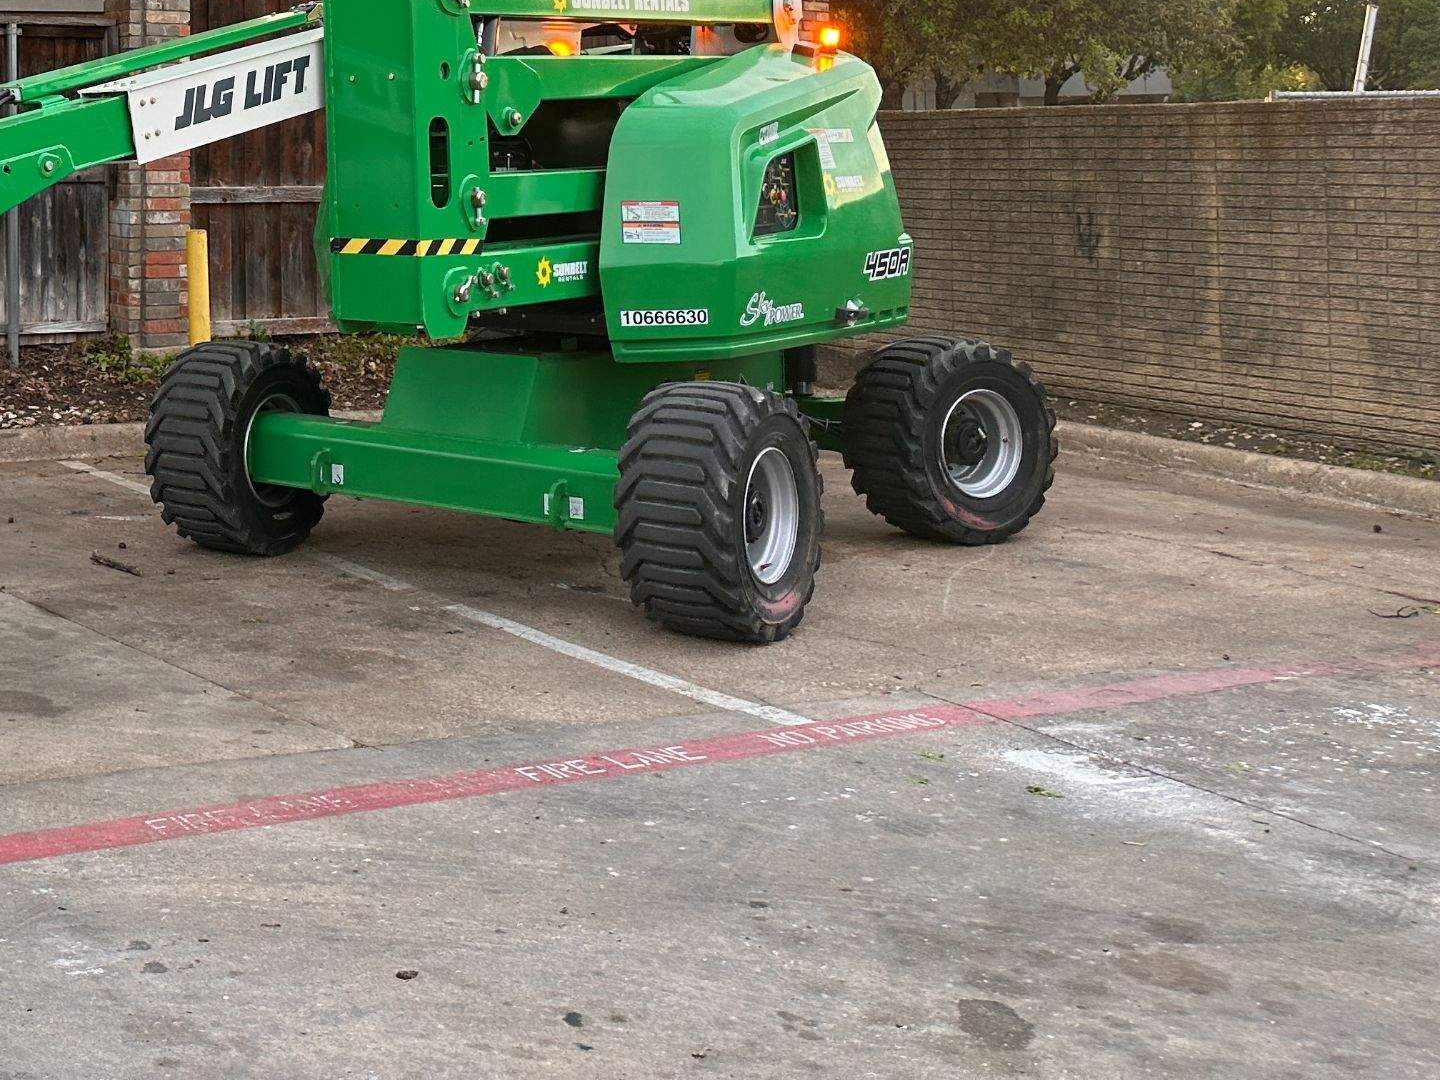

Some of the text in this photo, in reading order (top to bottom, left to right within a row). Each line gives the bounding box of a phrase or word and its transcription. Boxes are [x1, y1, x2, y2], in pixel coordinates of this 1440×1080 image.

[174, 54, 311, 131] JLG LIFT
[552, 261, 588, 276] SUNBELT
[863, 246, 911, 282] 450A
[622, 309, 708, 325] 10666630
[757, 713, 946, 748] NO PARKING
[513, 759, 608, 782] FIRE
[601, 746, 708, 770] LANE
